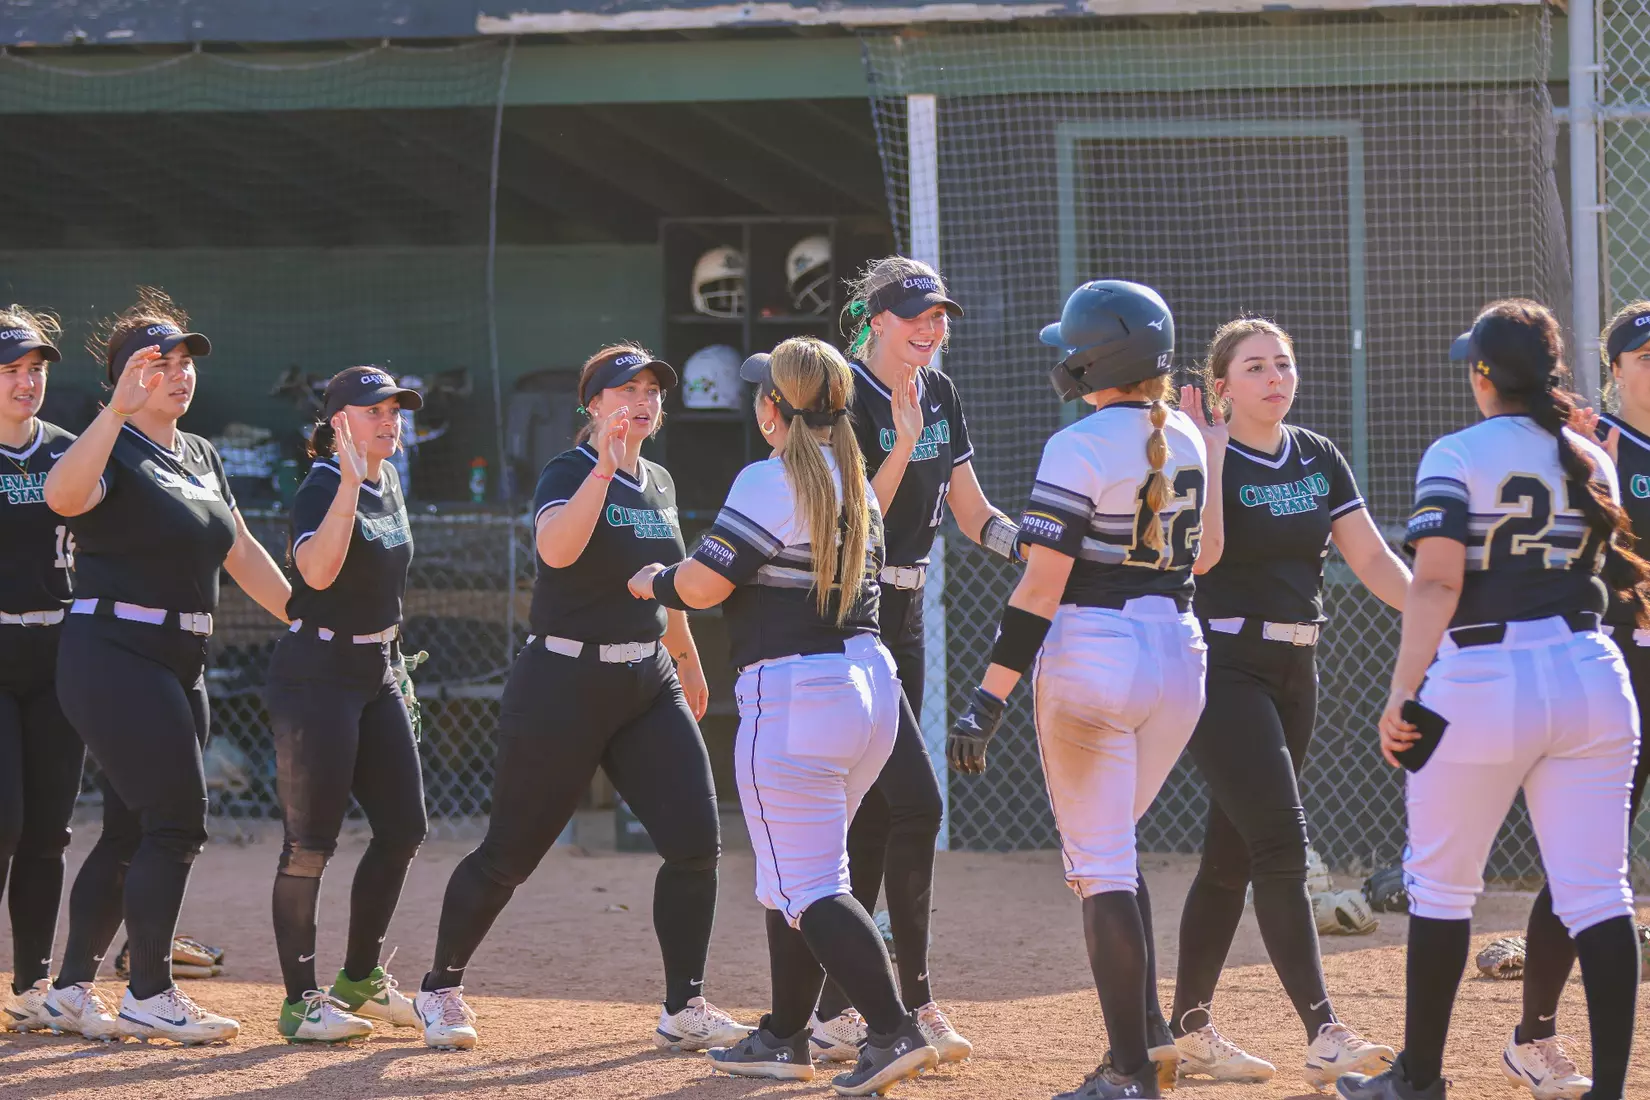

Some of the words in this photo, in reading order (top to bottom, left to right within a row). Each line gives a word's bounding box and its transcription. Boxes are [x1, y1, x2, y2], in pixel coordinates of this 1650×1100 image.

[1157, 353, 1168, 369] 12
[880, 419, 951, 452] CLLAND
[908, 442, 939, 462] ATE
[7, 487, 46, 504] STAT
[1269, 495, 1318, 517] STATE
[1022, 515, 1063, 534] HORIZON
[1122, 465, 1206, 571] 12
[703, 538, 735, 561] HORIZON
